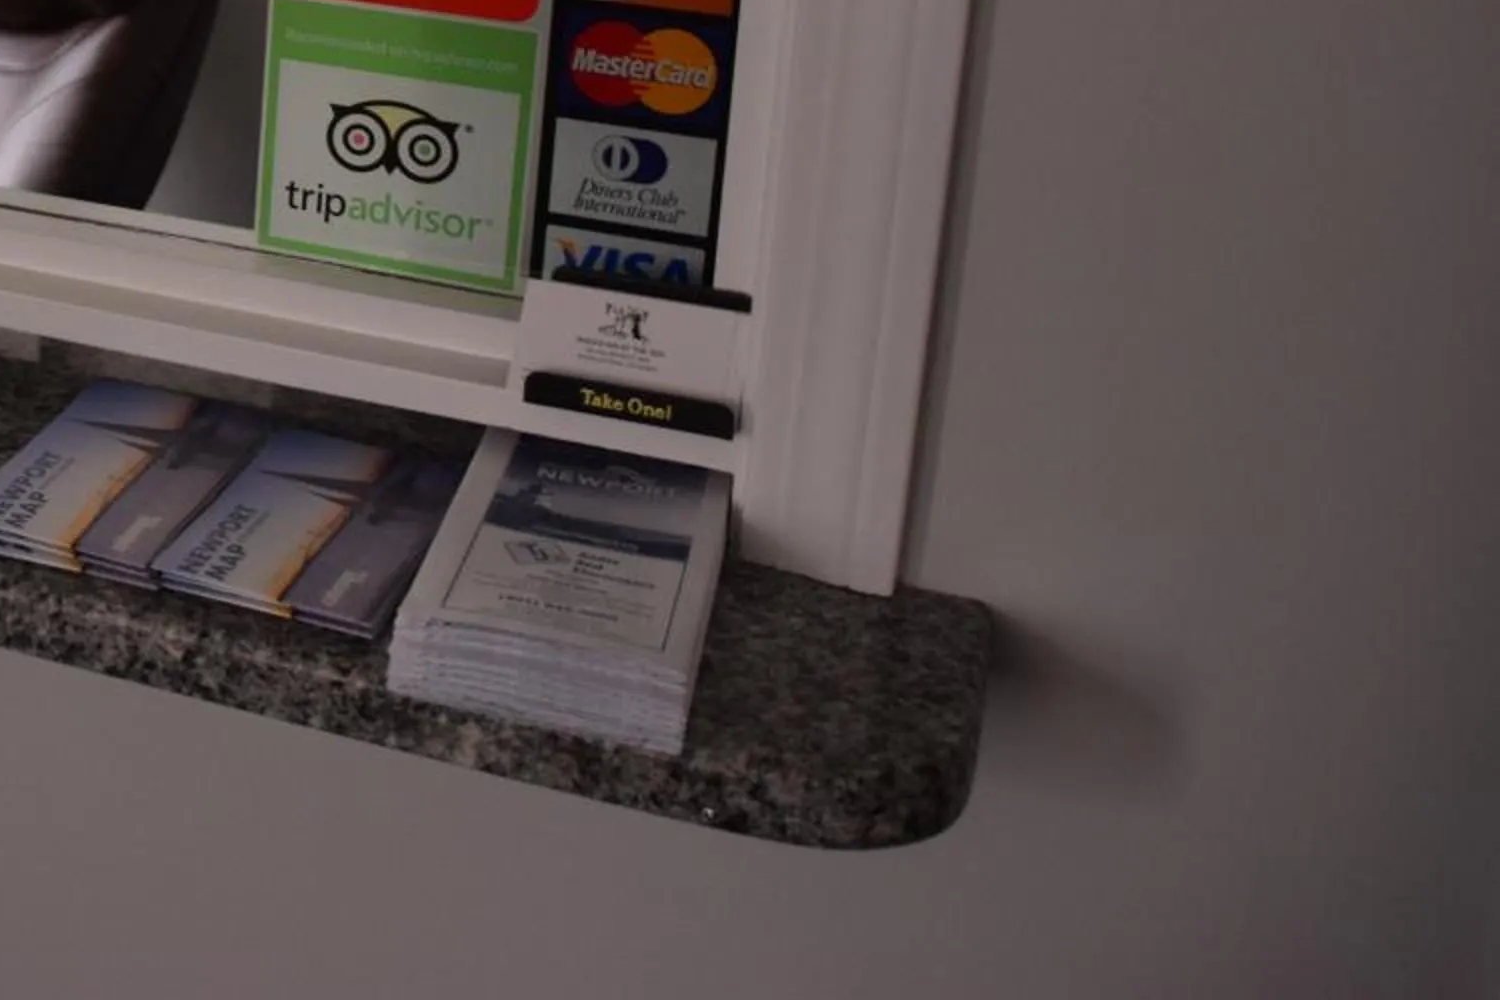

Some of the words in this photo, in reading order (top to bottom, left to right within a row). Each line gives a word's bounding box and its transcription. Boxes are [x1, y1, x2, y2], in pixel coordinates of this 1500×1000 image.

[572, 47, 710, 88] MasterCard
[285, 179, 483, 242] tripadvisor
[579, 176, 633, 203] Diners
[636, 184, 680, 208] Club
[556, 236, 690, 287] VISA
[580, 387, 624, 412] Take
[626, 397, 673, 421] One!
[3, 489, 49, 530] MAP
[177, 502, 260, 574] NEWPORT
[204, 542, 248, 583] MAP
